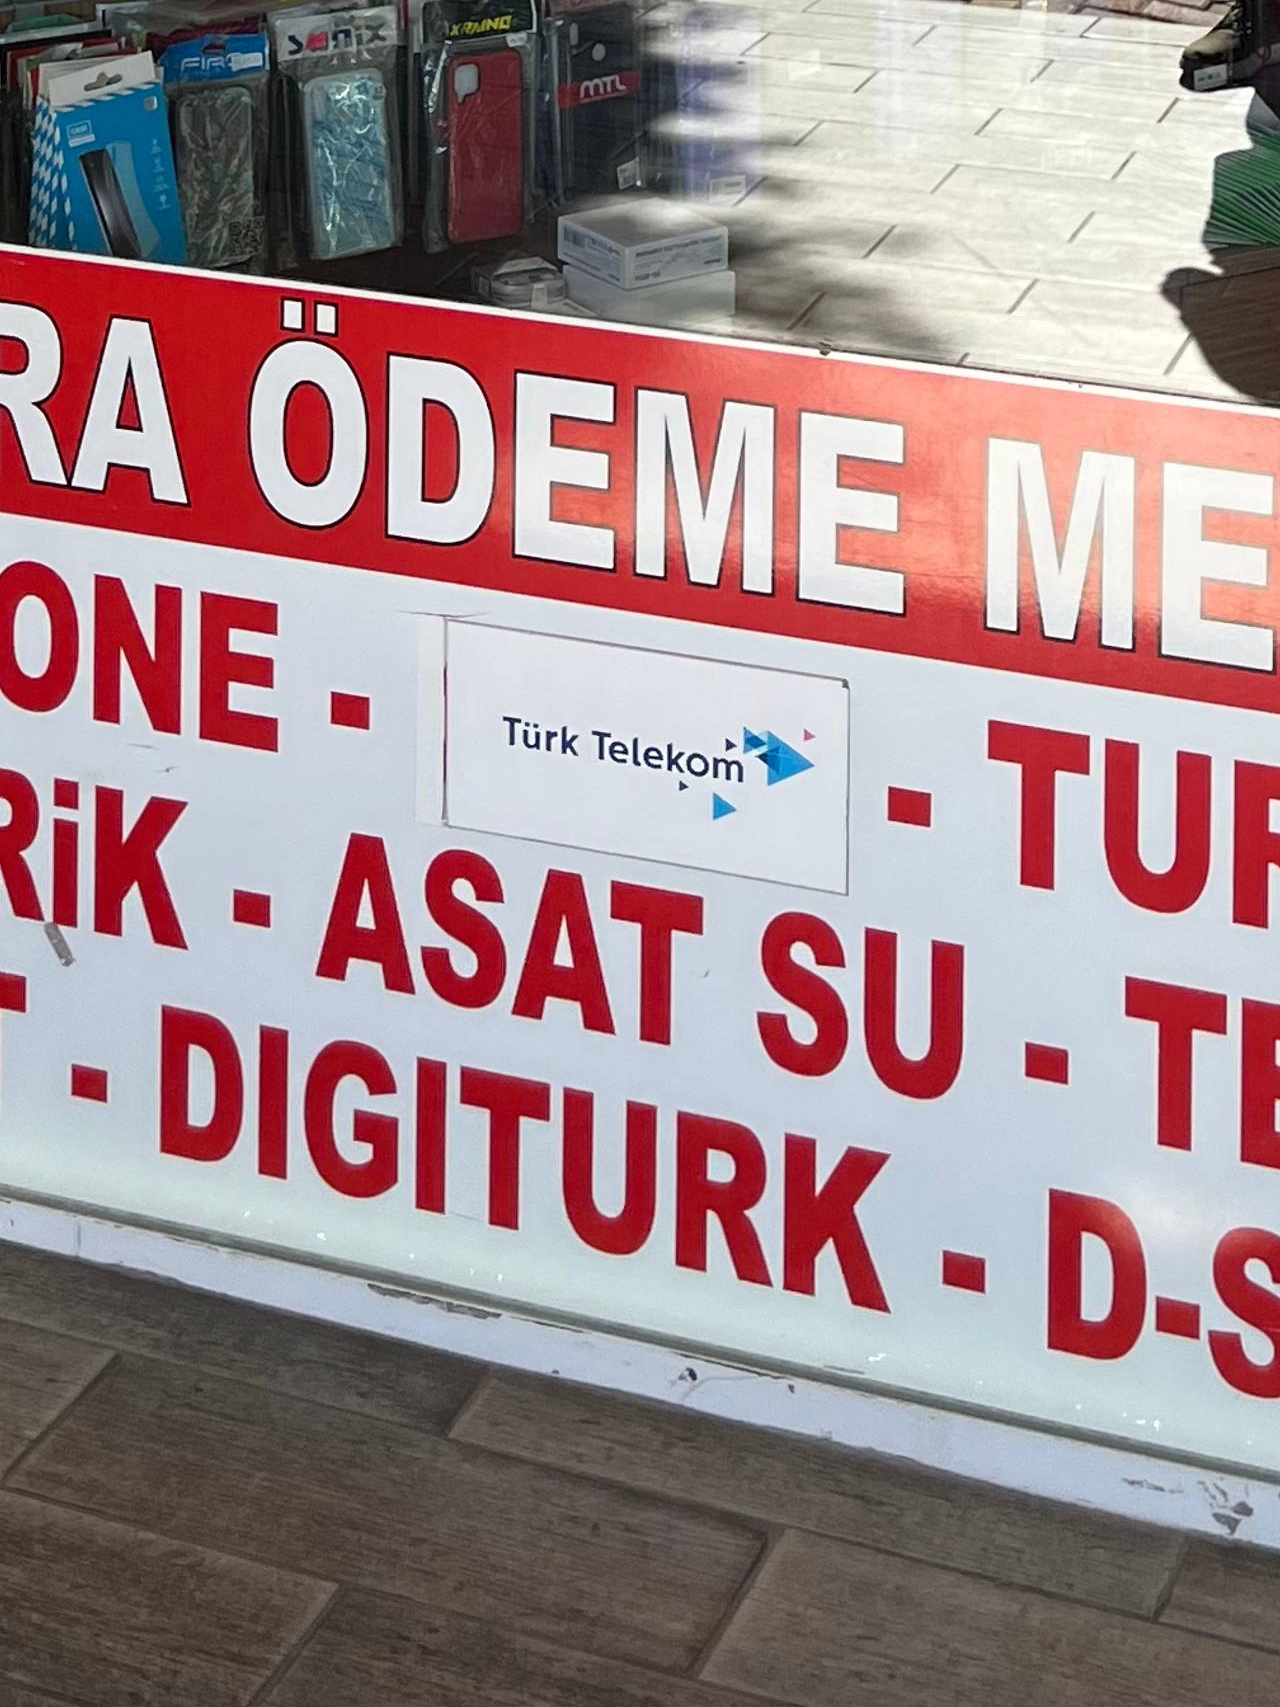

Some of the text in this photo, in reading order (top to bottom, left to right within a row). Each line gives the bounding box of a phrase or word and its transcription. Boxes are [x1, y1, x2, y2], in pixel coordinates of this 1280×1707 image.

[248, 296, 907, 617] ÖDEME
[330, 691, 371, 732] -
[502, 715, 744, 784] Türk Telekom
[886, 785, 933, 830] -
[231, 889, 272, 928] -
[317, 833, 705, 1047] ASAT
[756, 911, 965, 1101] SU
[1024, 1041, 1069, 1086] -
[70, 1061, 110, 1103] -
[159, 1004, 891, 1314] DIGITURK
[941, 1248, 987, 1293] -
